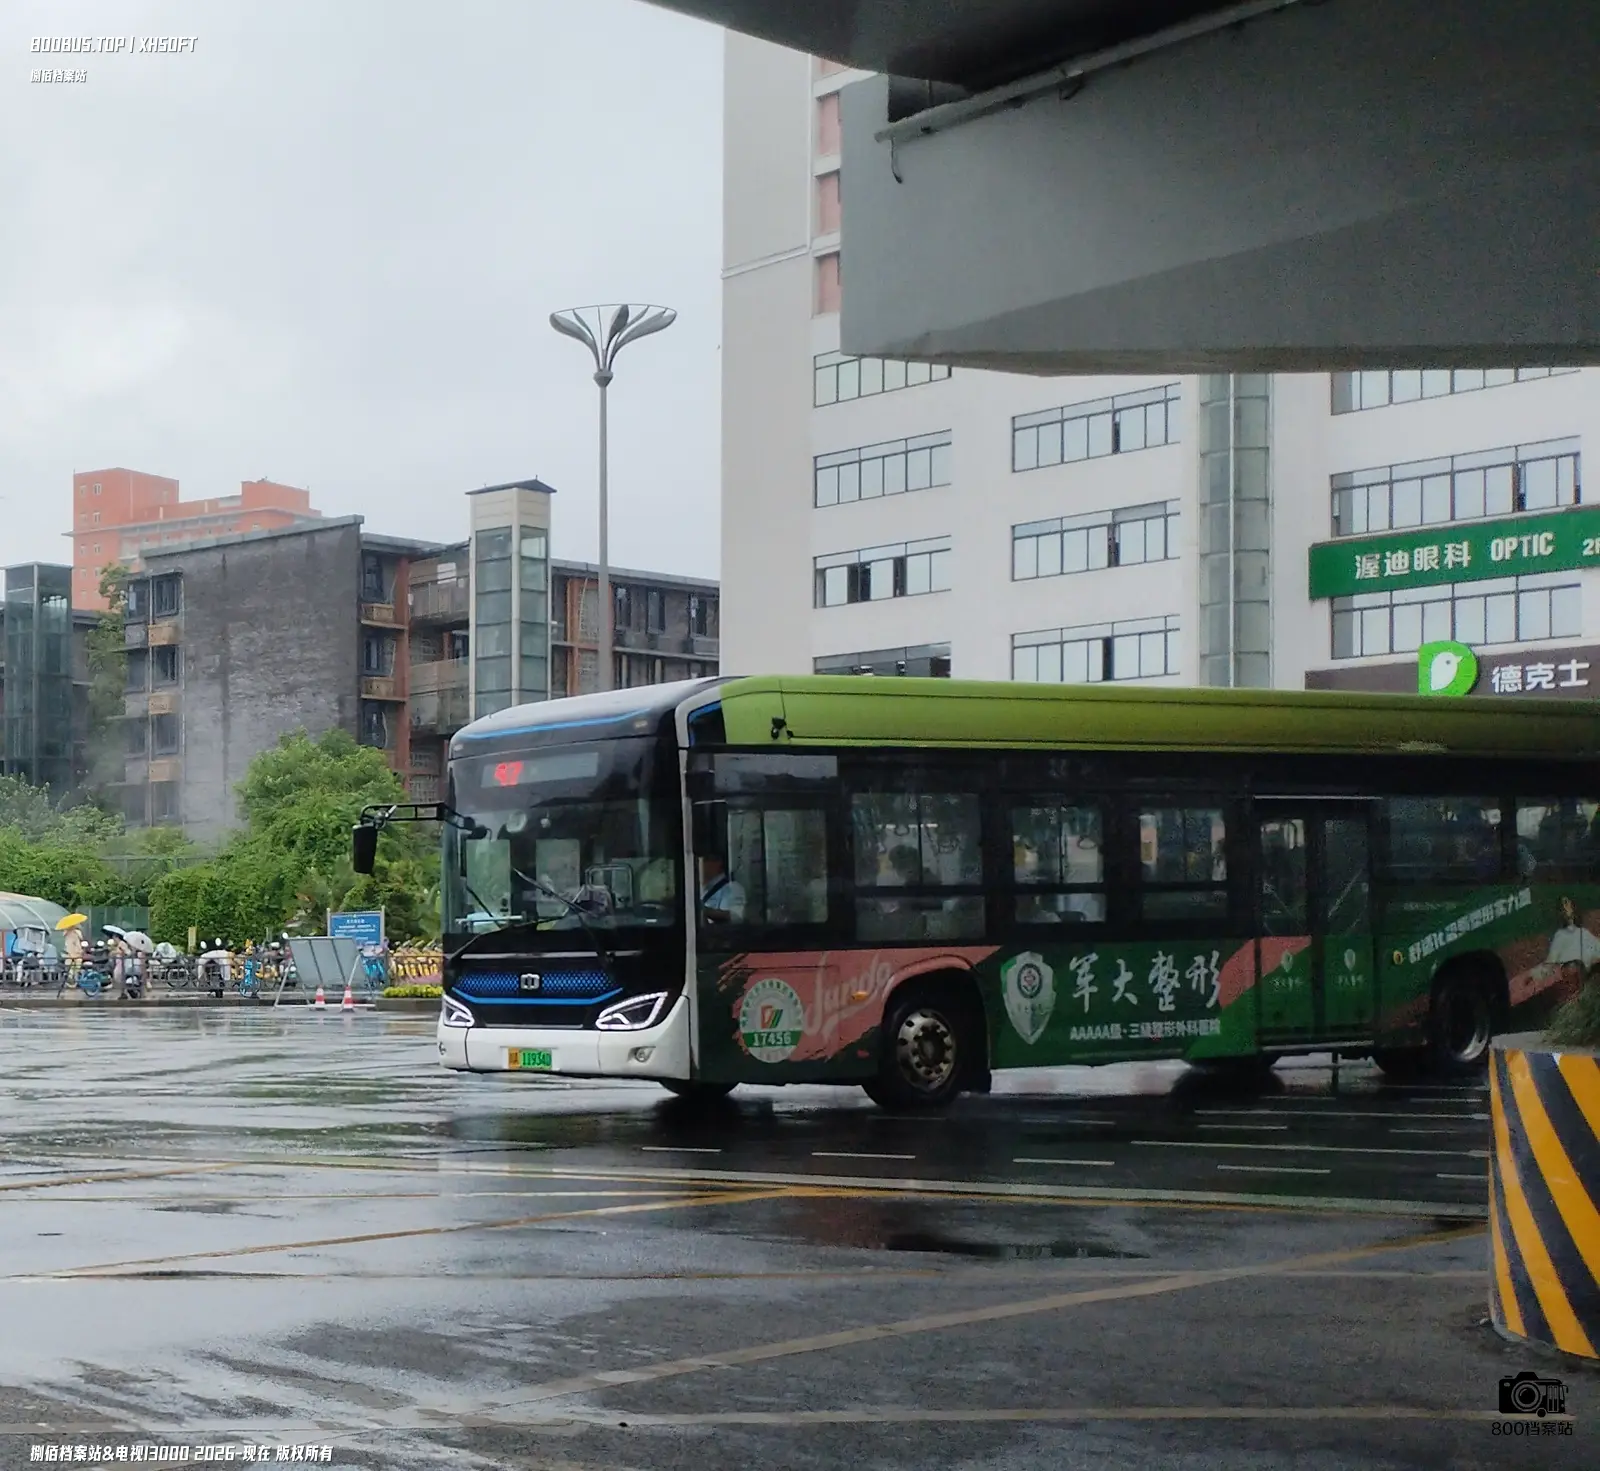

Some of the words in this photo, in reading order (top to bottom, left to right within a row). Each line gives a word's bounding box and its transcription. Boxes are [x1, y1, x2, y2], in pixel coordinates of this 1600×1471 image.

[1355, 541, 1472, 580] 渥迪眼科
[1490, 531, 1555, 562] OPTIC
[1491, 659, 1591, 694] 德克士
[752, 1031, 792, 1047] 17456
